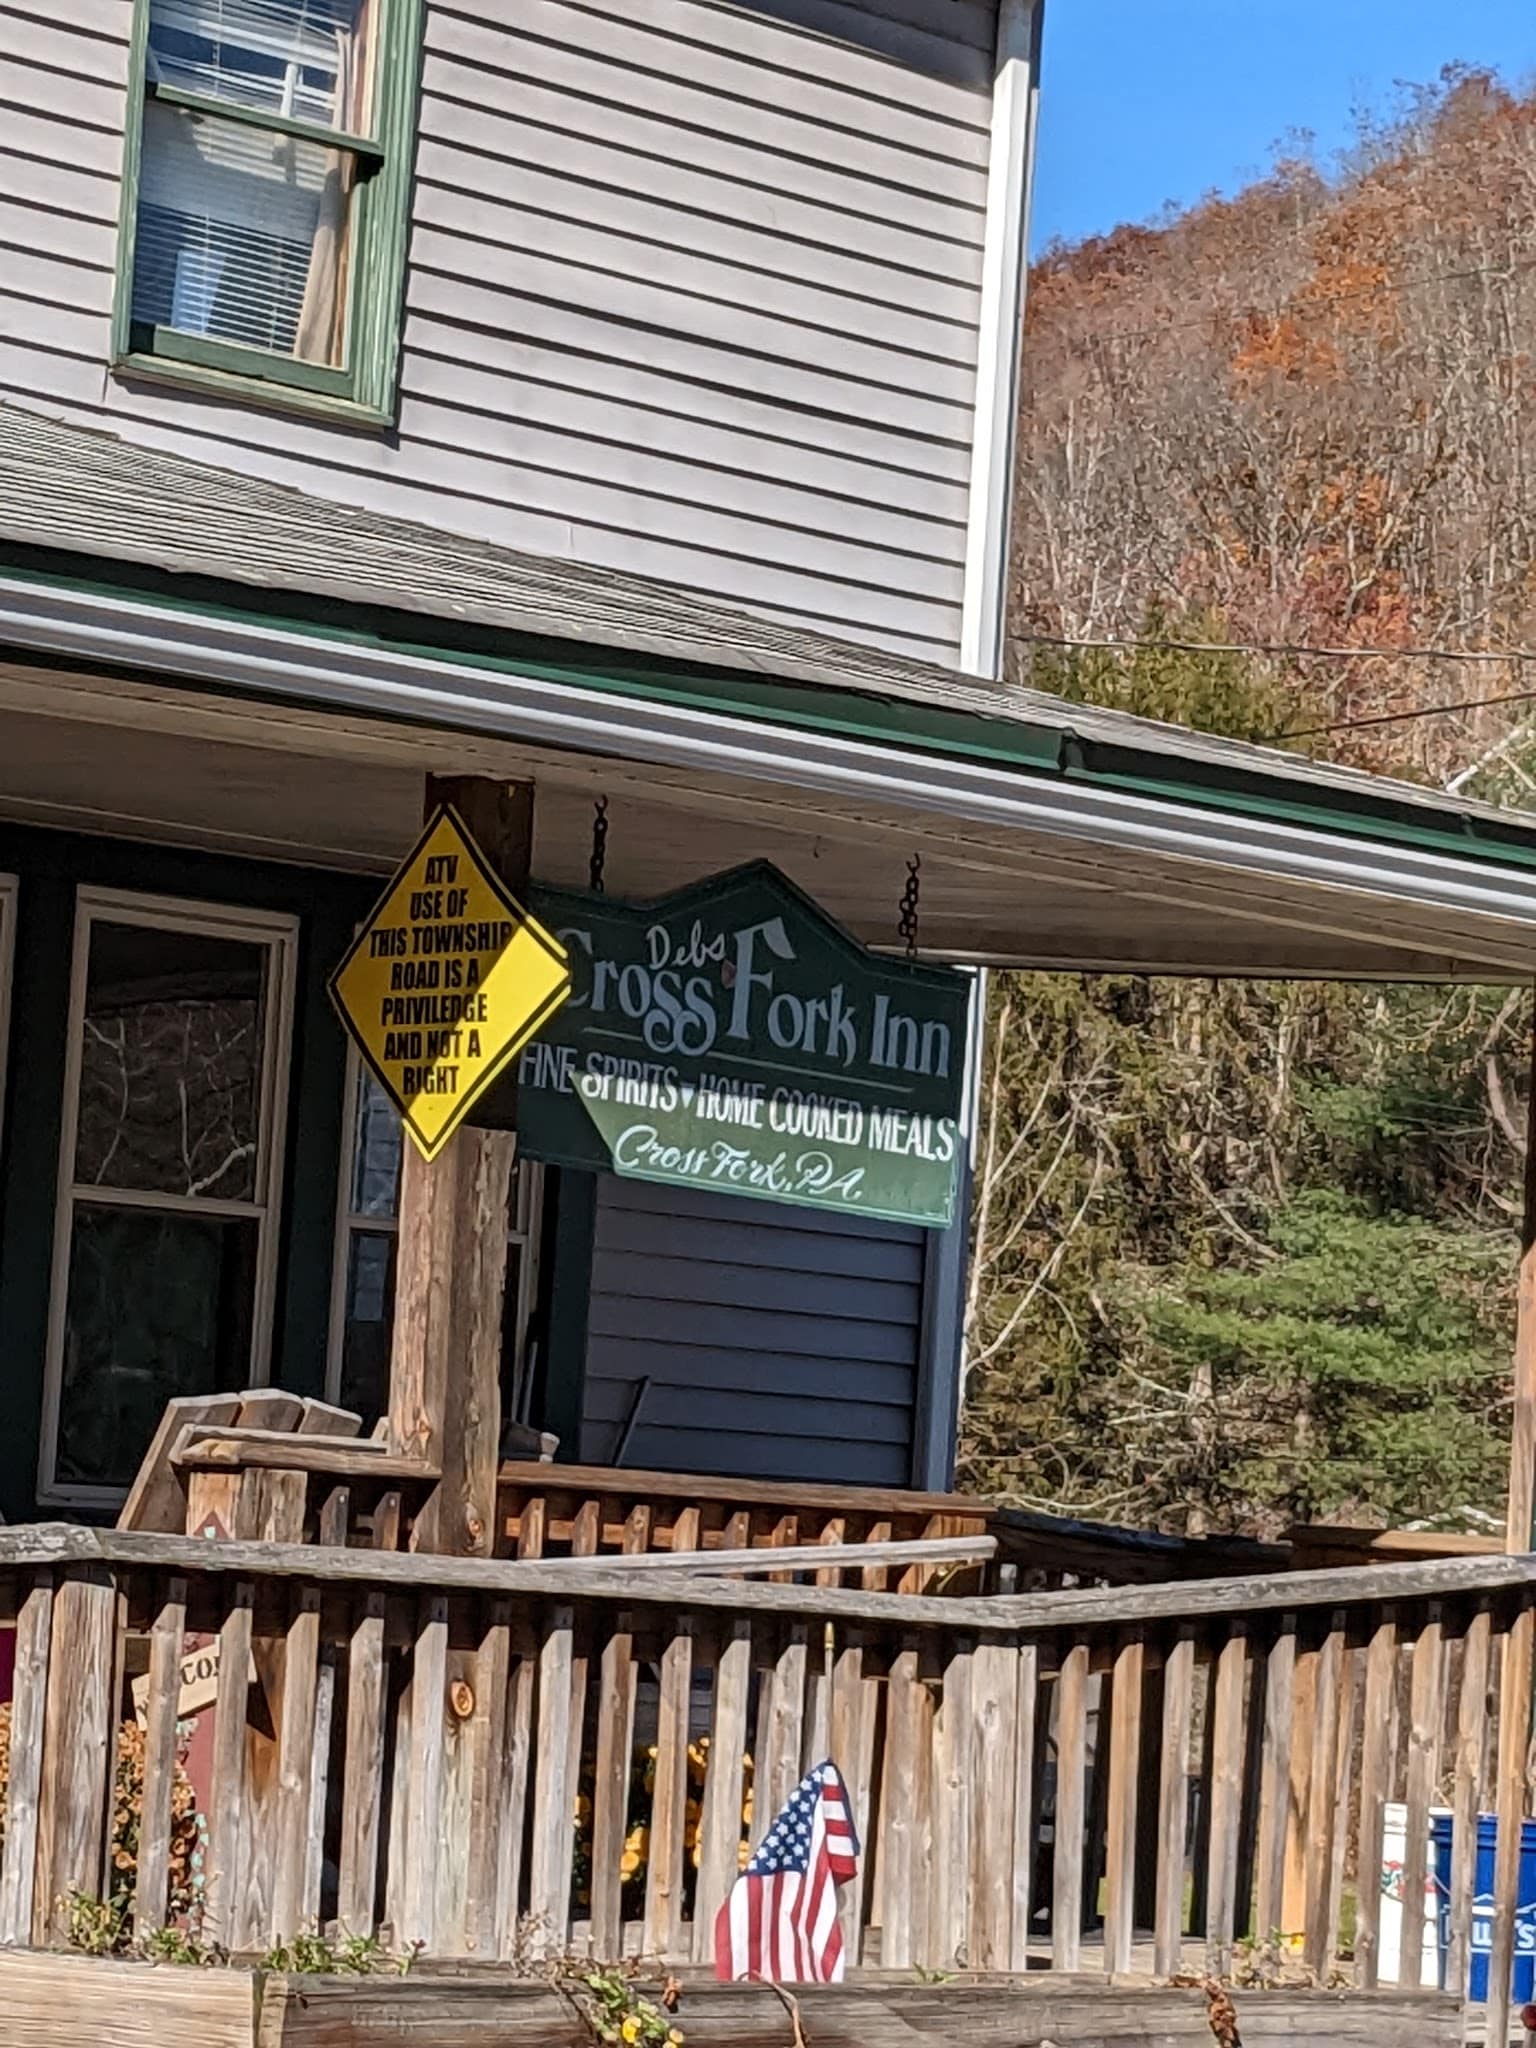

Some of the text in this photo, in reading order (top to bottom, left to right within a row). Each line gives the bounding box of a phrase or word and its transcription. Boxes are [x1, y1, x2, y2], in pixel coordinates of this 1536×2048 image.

[424, 855, 459, 884] ATV
[409, 888, 469, 921] USE OF
[370, 921, 513, 958] THIS TOWNSHIP
[646, 919, 725, 971] Debs
[390, 957, 480, 990] ROAD IS A
[381, 993, 488, 1027] PRIVILEDGE
[726, 916, 857, 1069] Fork
[868, 994, 951, 1078] Inn
[383, 1028, 481, 1061] AND NOT A
[402, 1066, 460, 1096] RIGHT
[518, 1041, 956, 1162] FINE SPIRITS HOME COOKED MEALS
[614, 1124, 709, 1174] Cross
